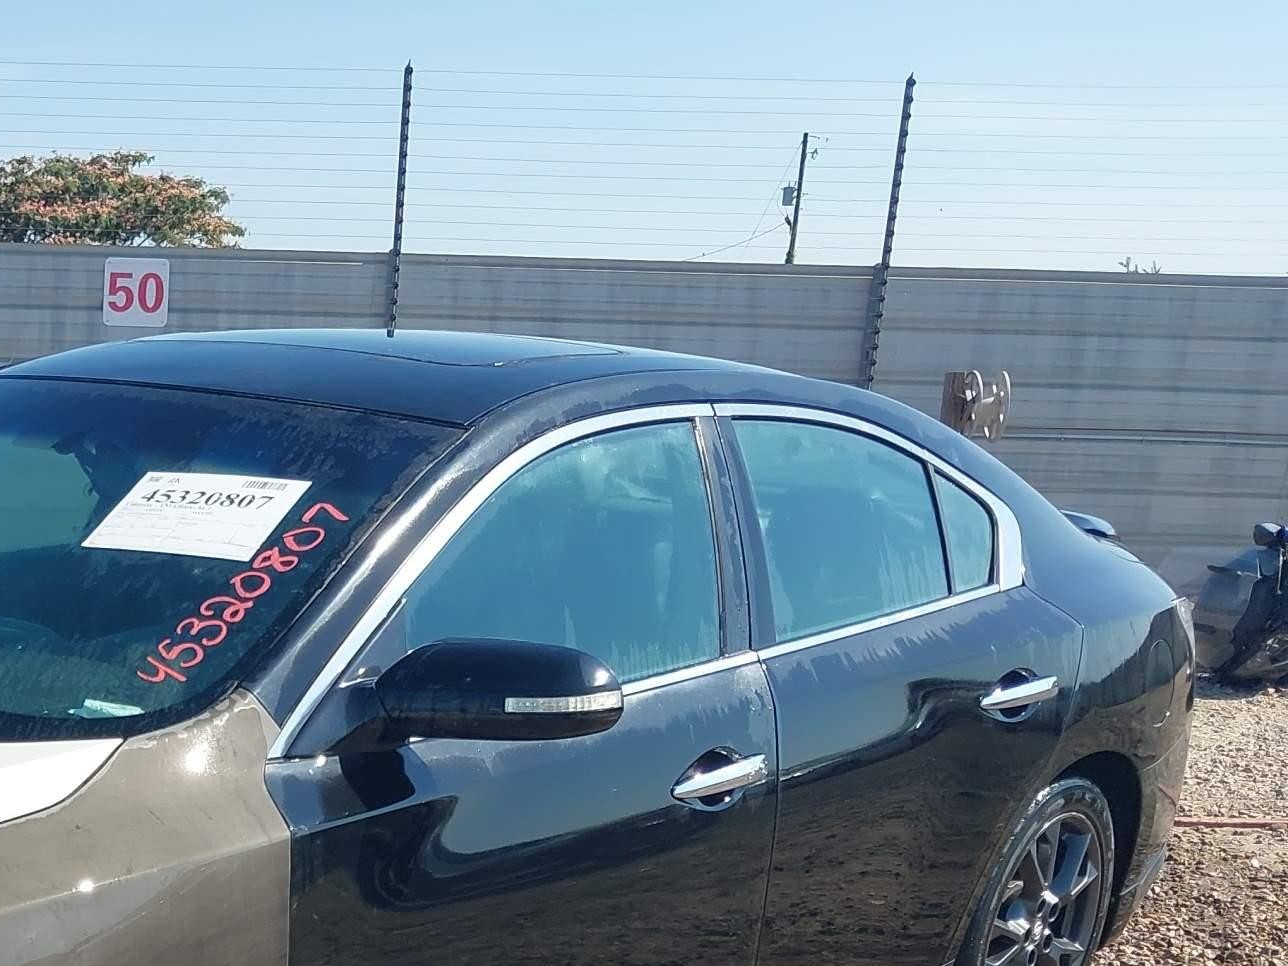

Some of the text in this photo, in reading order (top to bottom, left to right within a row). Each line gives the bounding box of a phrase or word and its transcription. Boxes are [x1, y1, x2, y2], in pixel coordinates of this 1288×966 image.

[108, 272, 165, 314] 50
[141, 488, 275, 510] 45320807
[137, 503, 350, 683] 45320807
